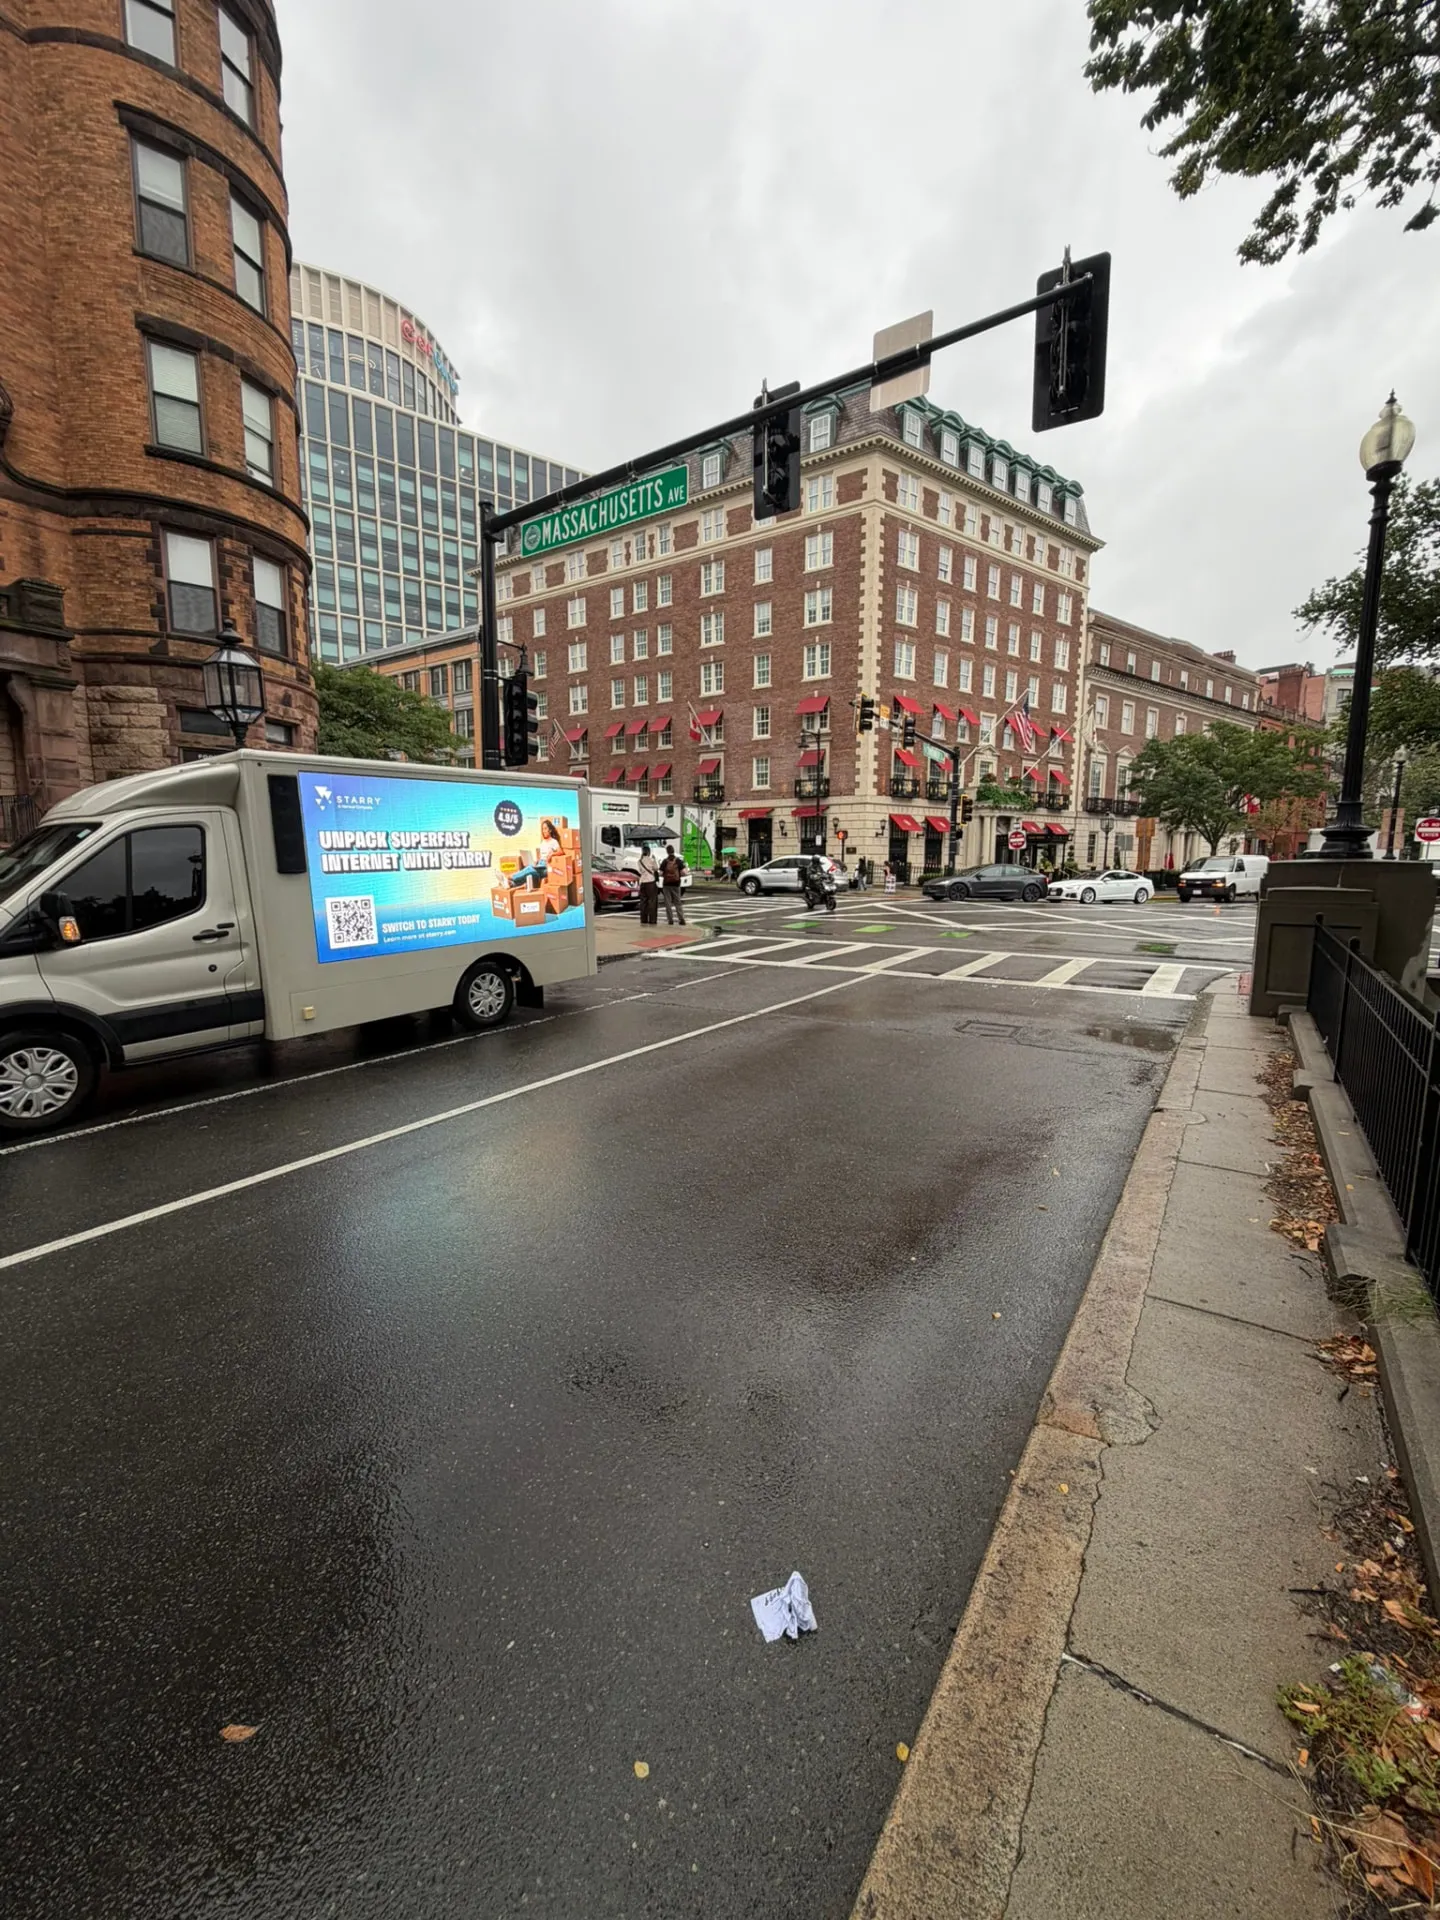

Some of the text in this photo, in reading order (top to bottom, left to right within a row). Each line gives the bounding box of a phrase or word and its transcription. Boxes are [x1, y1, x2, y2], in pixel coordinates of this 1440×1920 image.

[542, 478, 685, 546] MASSACHUSETTS AVE
[336, 795, 381, 805] STARRY
[318, 830, 469, 850] UNPACK SUPERFAST
[321, 851, 492, 874] INTERNET WITH STARRY
[382, 913, 480, 933] SWITCH TO STARRY TODAY
[383, 935, 401, 943] Learn
